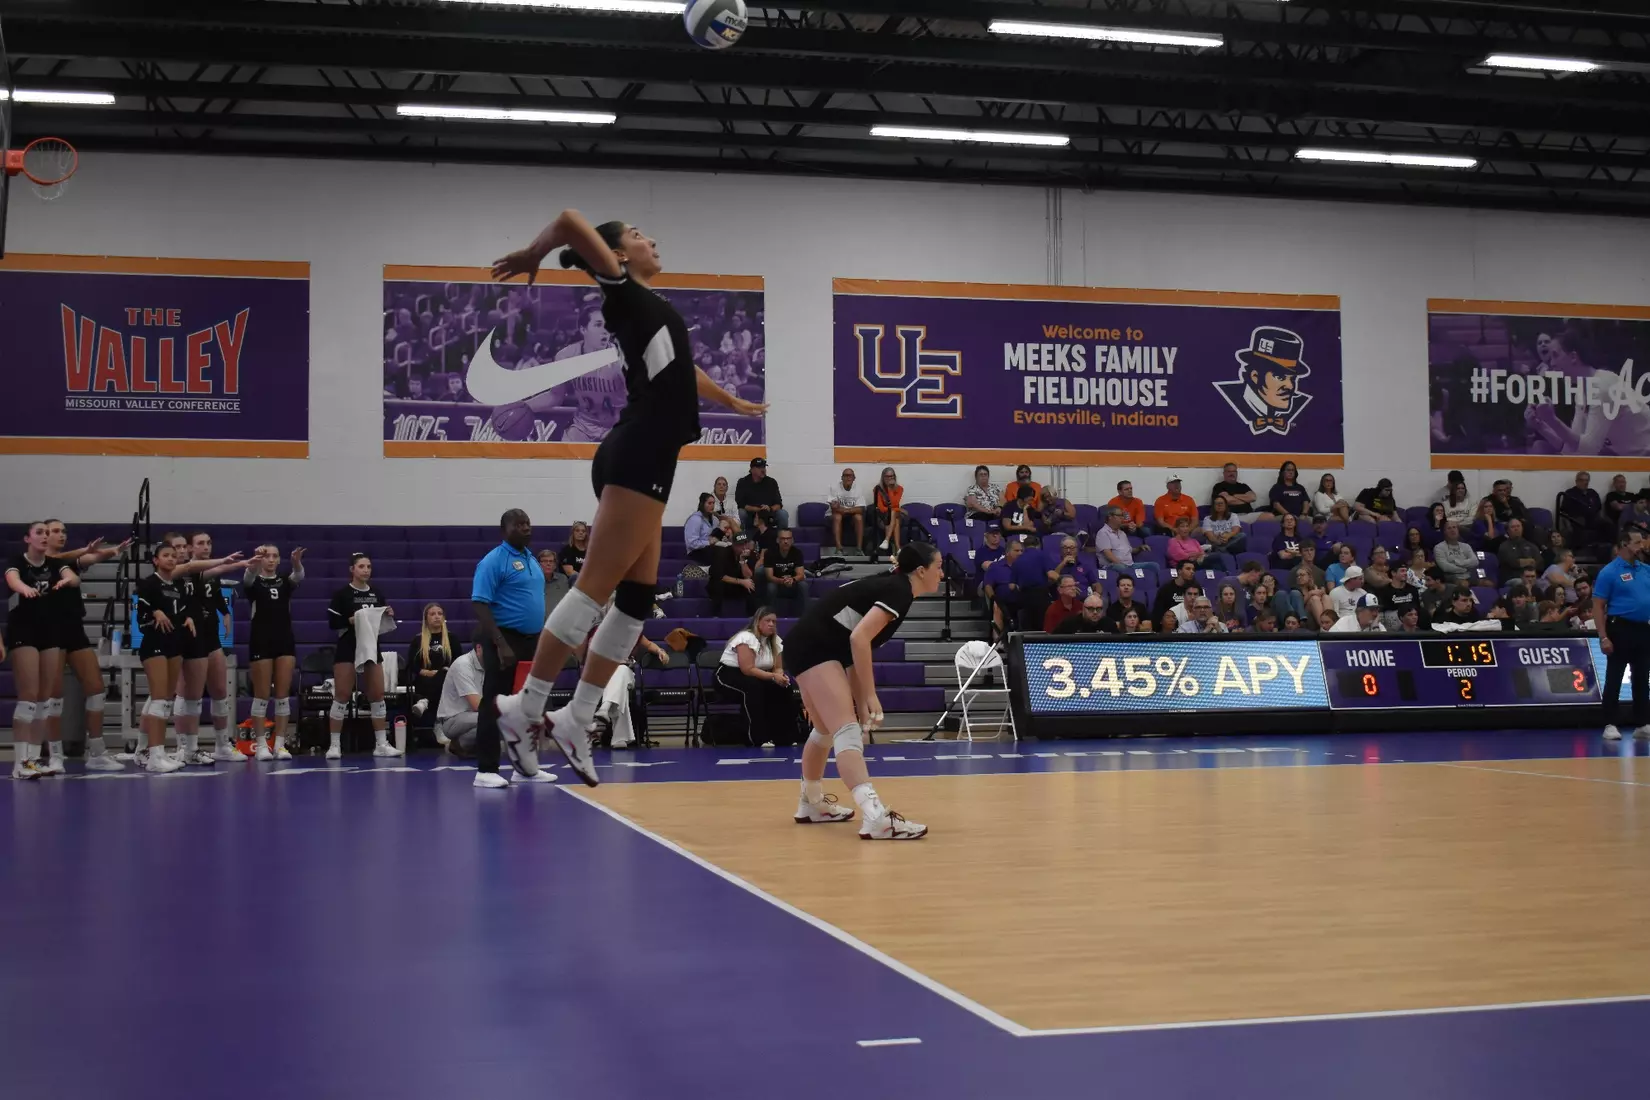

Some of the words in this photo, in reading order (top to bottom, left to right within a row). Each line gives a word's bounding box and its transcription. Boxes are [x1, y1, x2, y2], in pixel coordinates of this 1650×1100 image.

[125, 308, 181, 326] THE
[1042, 324, 1121, 340] Welcome
[1126, 327, 1144, 341] to
[61, 303, 250, 394] VALLEY
[1004, 343, 1086, 372] MEEKS
[1095, 345, 1178, 374] FAMILY
[854, 324, 962, 419] UE
[1024, 376, 1168, 406] FIELDHOUSE
[66, 399, 121, 408] MISSOURI
[126, 400, 165, 409] VALLEY
[168, 401, 240, 411] CONFERENCE
[1013, 409, 1106, 427] Evansville,
[1111, 411, 1178, 427] Indiana
[205, 584, 212, 597] 2
[270, 588, 279, 599] 9
[1346, 649, 1395, 667] HOME
[1447, 643, 1493, 664] 1:15
[1518, 647, 1570, 665] GUEST
[1042, 656, 1199, 698] 3.45%
[1213, 655, 1310, 696] APY
[1447, 668, 1478, 678] PERIOD
[1572, 670, 1584, 691] 2
[1362, 674, 1378, 695] 0
[1460, 679, 1472, 699] 2
